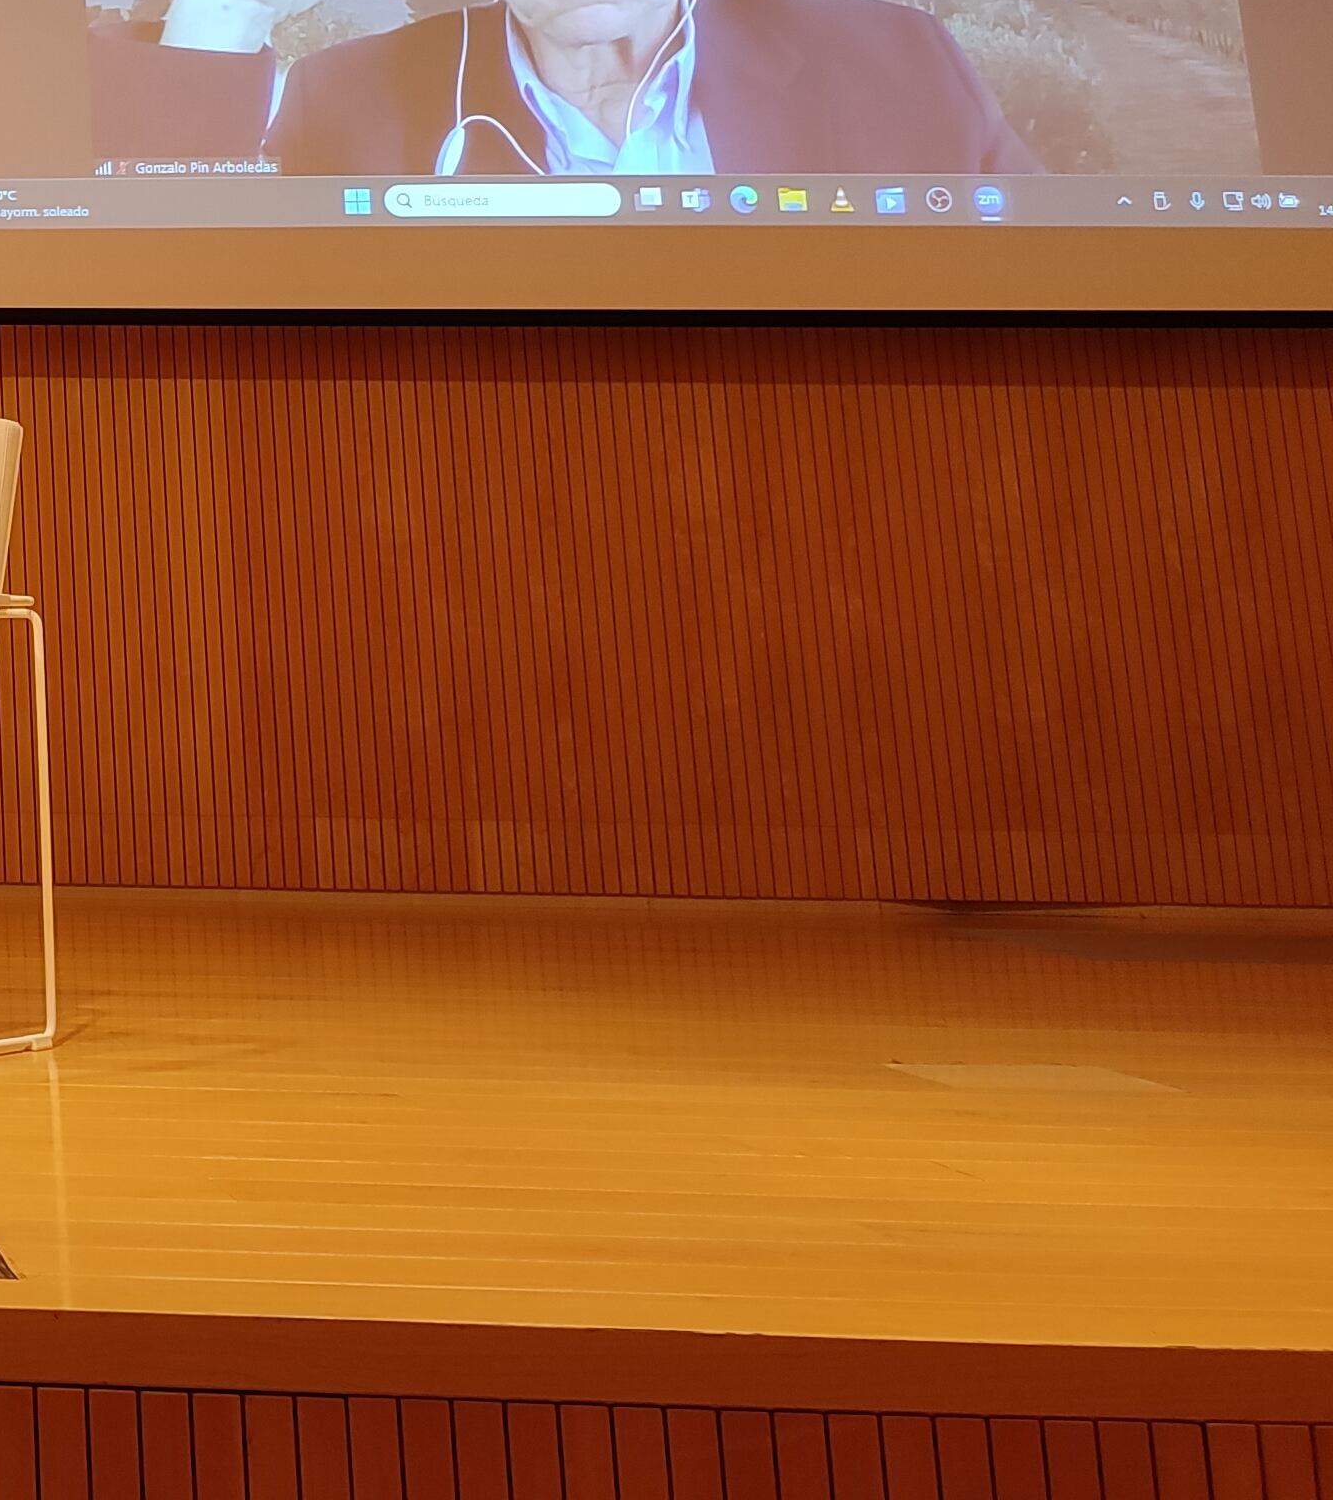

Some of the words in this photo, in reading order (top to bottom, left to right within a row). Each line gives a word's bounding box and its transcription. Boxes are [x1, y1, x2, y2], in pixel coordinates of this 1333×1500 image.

[134, 162, 186, 175] Gonzalo
[190, 161, 210, 174] Pin
[212, 160, 278, 174] Arboledas
[42, 205, 90, 218] soleado
